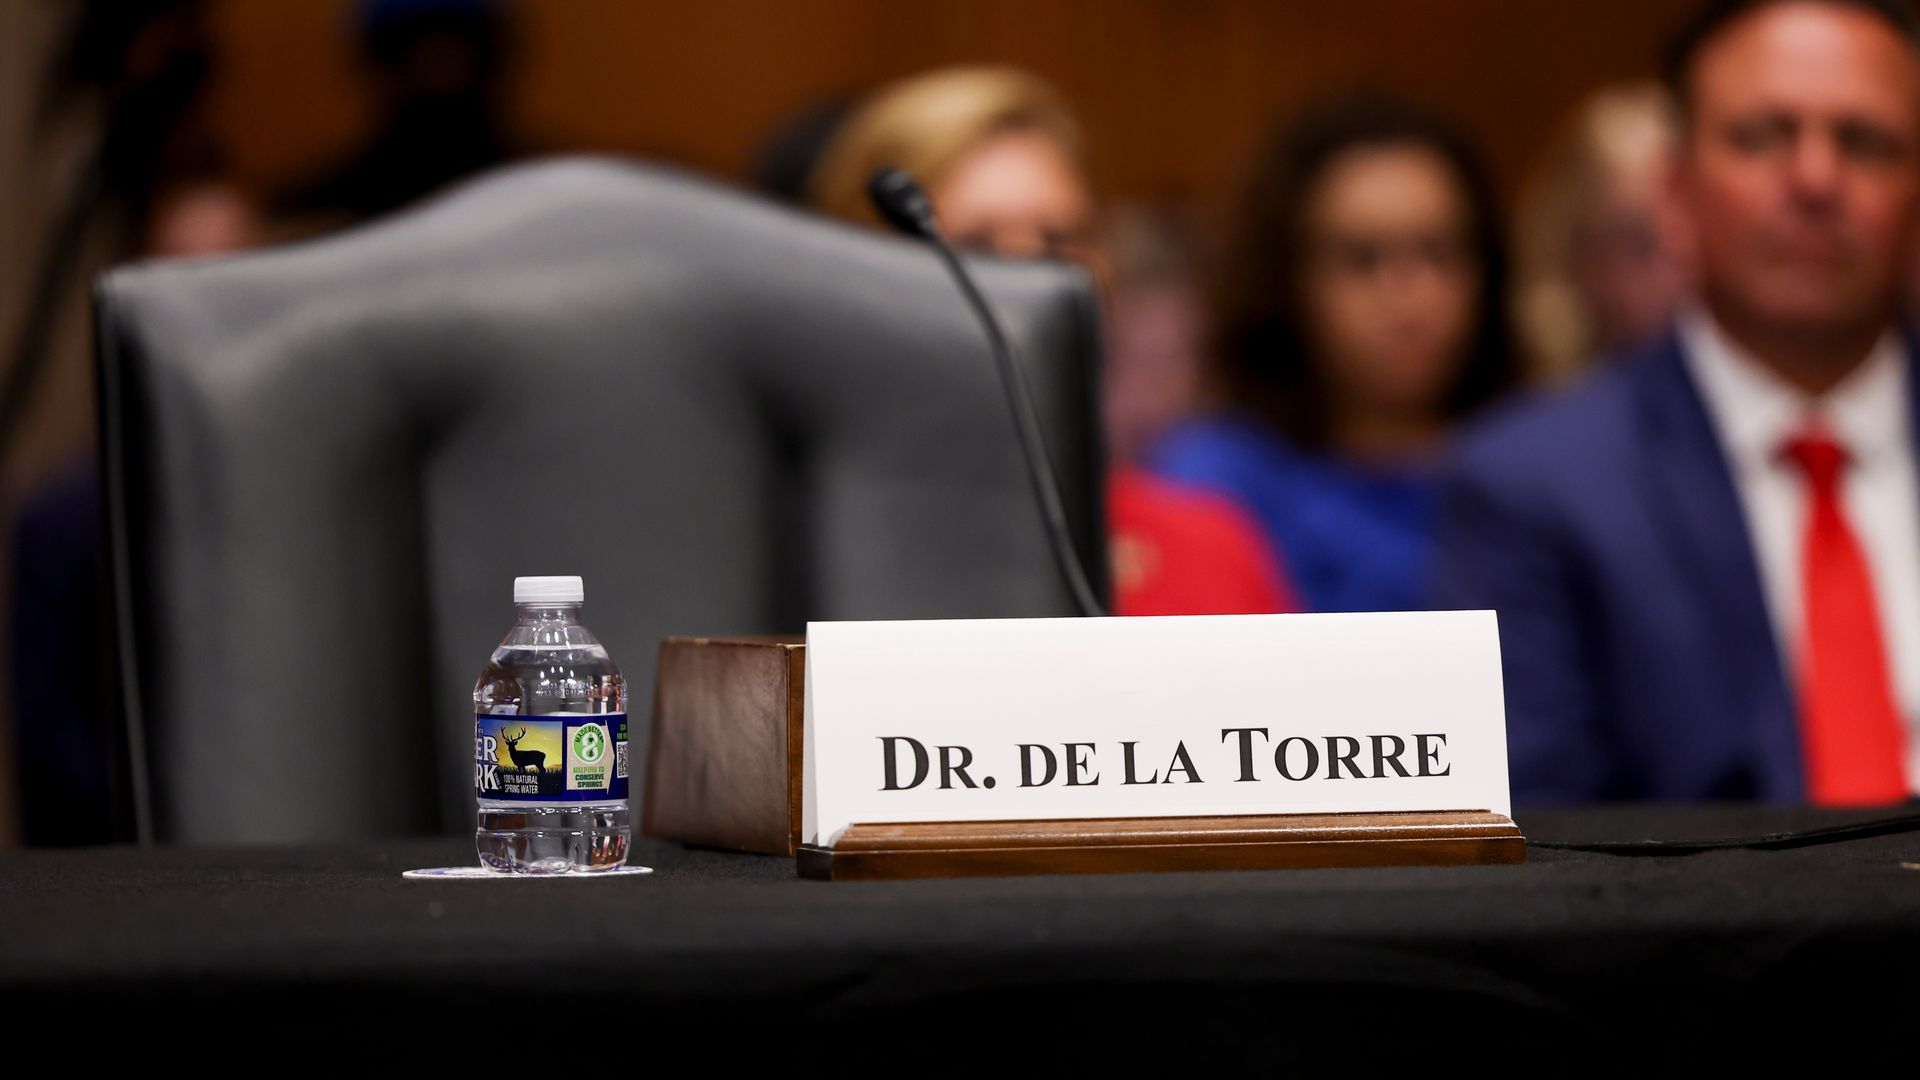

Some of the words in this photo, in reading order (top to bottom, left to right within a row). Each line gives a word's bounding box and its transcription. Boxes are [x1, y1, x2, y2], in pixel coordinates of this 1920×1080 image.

[880, 736, 996, 791] DR.
[1017, 743, 1100, 788] DE
[1119, 741, 1204, 785] LA
[1221, 727, 1451, 783] TORRE
[503, 774, 514, 783] 100%
[516, 775, 538, 784] NATURAL
[505, 784, 519, 793] SPRING
[521, 785, 538, 794] WATER
